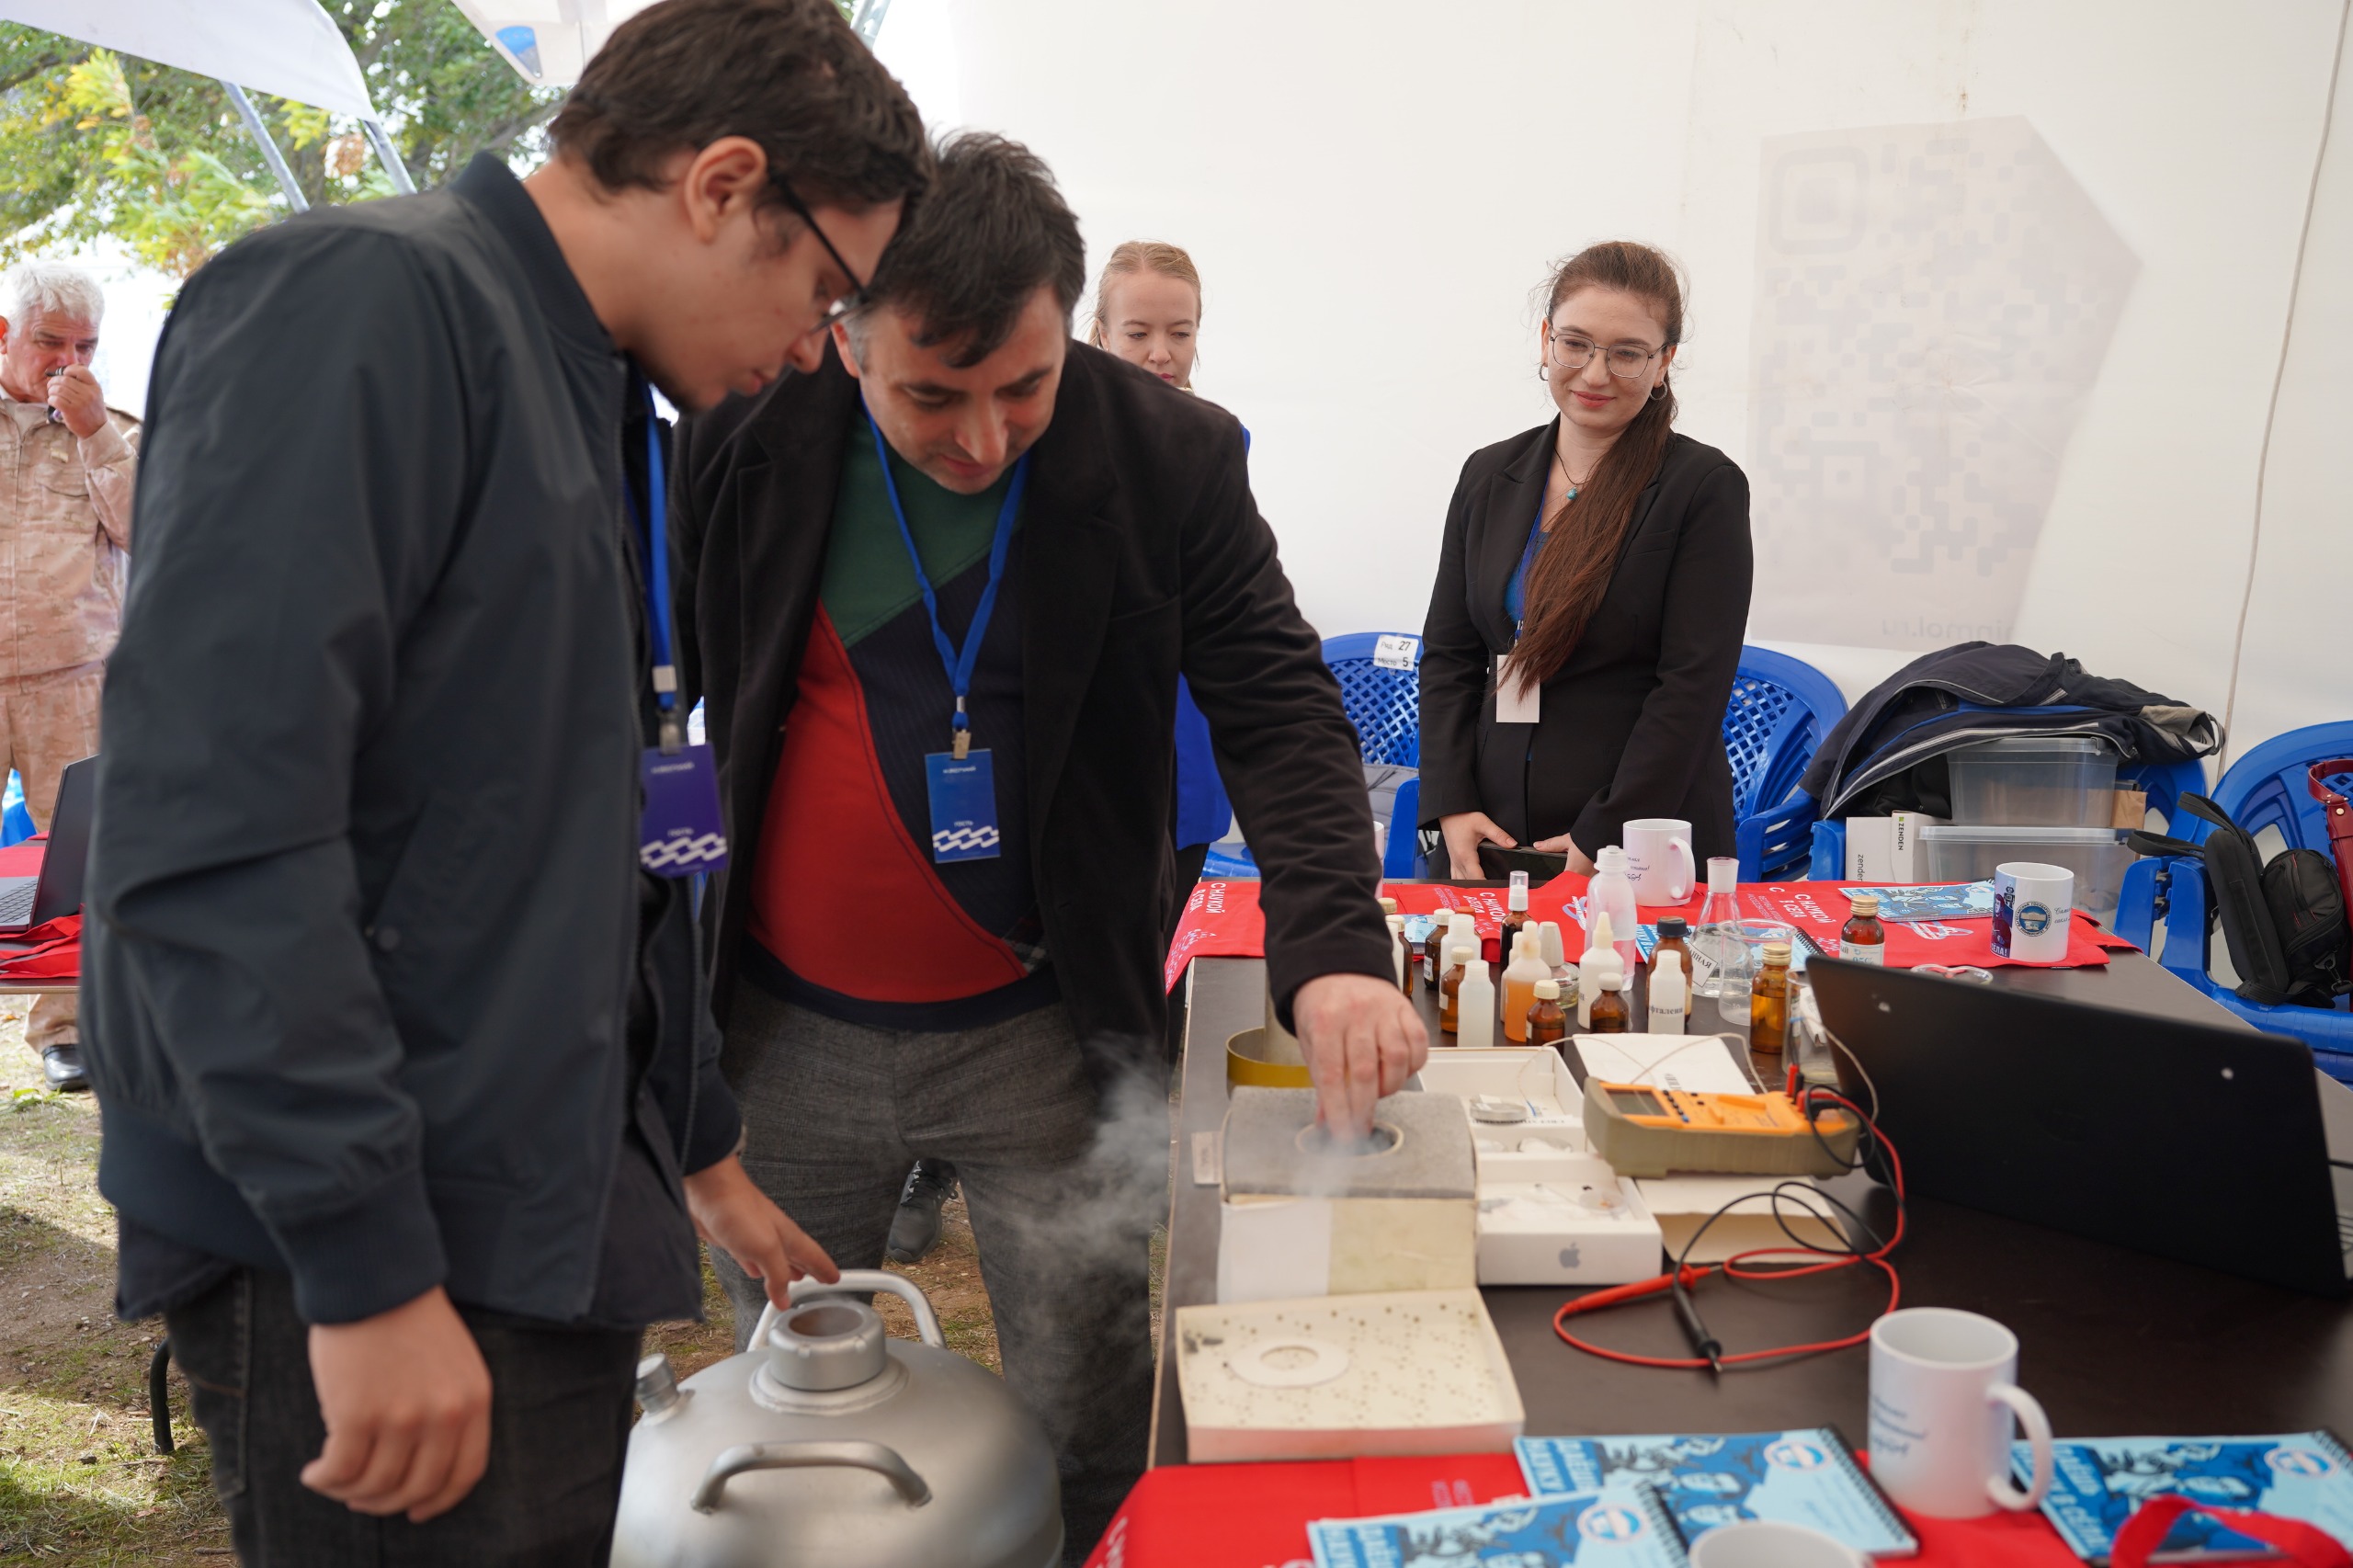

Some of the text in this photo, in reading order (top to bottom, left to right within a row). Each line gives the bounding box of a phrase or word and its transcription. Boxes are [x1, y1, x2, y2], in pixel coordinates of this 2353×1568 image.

[1398, 641, 1411, 651] 27
[1403, 656, 1409, 667] 5
[1206, 888, 1226, 914] НАУКОЙ
[1799, 900, 1837, 924] НАУКОЙ
